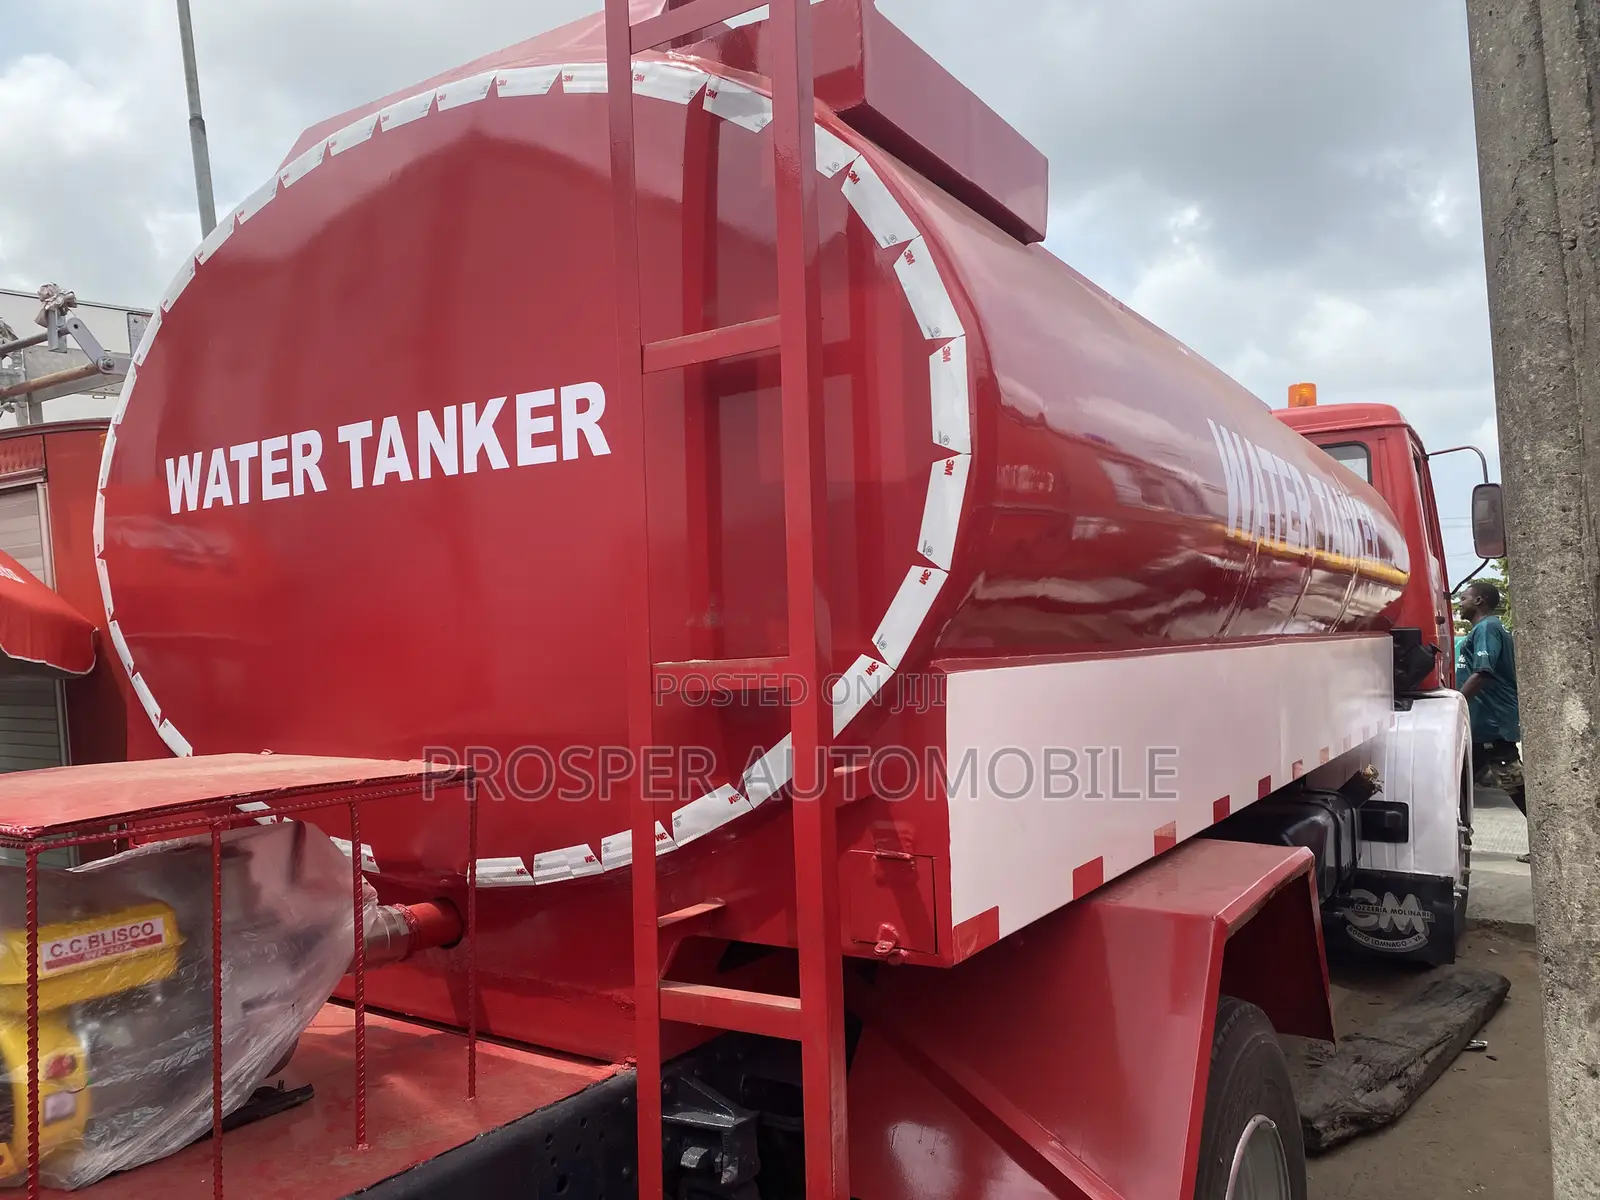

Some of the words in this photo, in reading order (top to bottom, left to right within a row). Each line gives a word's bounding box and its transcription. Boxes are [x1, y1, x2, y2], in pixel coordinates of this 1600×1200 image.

[497, 79, 507, 87] 3M
[563, 75, 574, 83] 3M
[633, 73, 645, 83] 3M
[705, 88, 717, 100] 3M
[848, 170, 860, 185] 3M
[903, 249, 915, 266] 3M
[942, 345, 952, 362] 3M
[166, 429, 327, 515] WATER
[338, 381, 611, 489] TANKER
[944, 459, 955, 476] 3M
[1207, 418, 1316, 551] WATER
[919, 569, 931, 586] 3M
[865, 661, 879, 677] 3M
[728, 793, 741, 805] 3M
[655, 832, 668, 842] 3M
[584, 855, 596, 864] 3M
[515, 868, 527, 876] 3M
[50, 922, 154, 958] C.C.BLISCO
[1371, 939, 1407, 948] LOMNAGO
